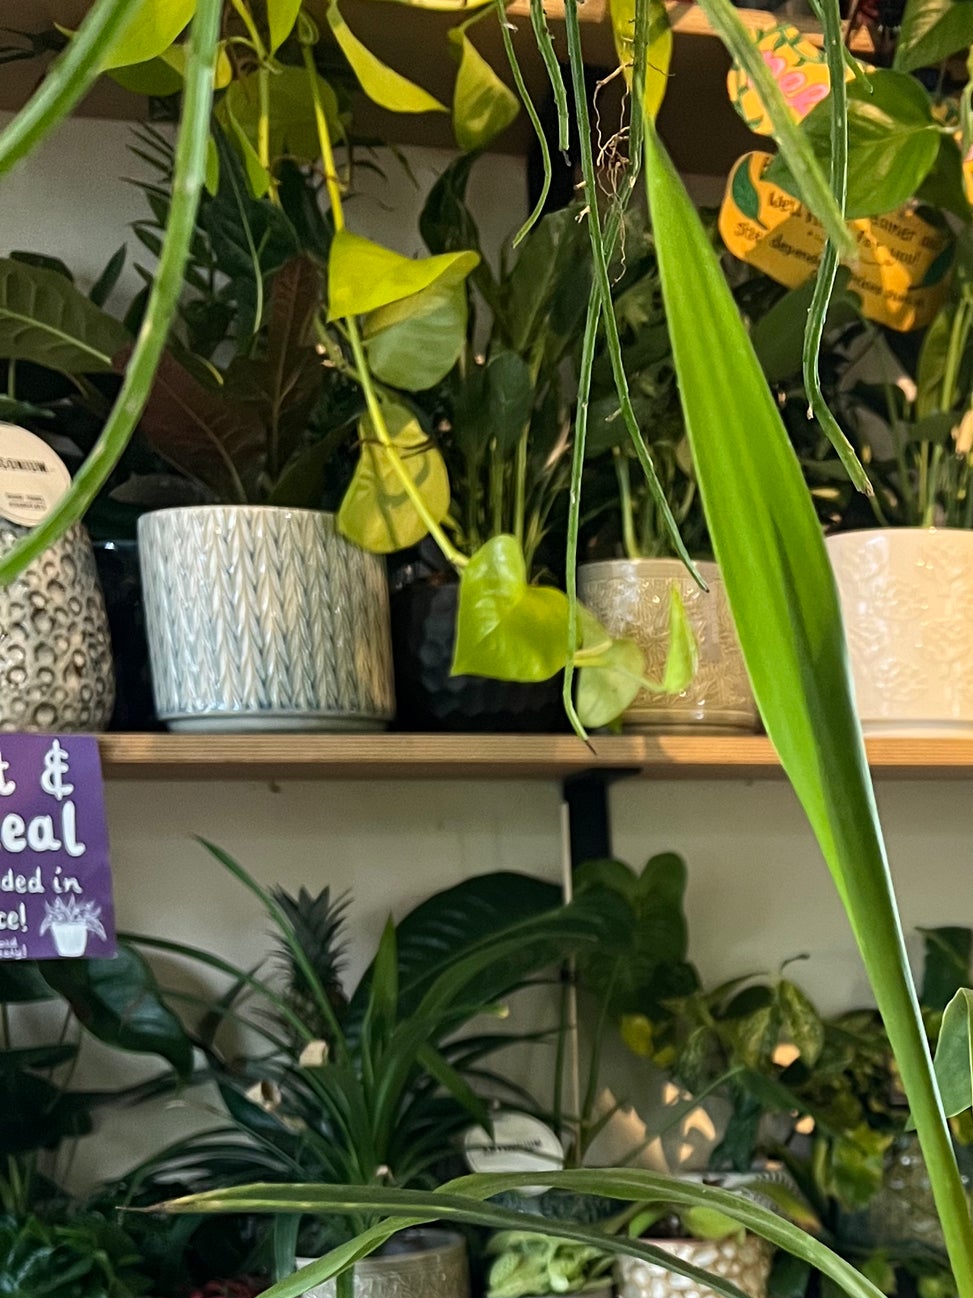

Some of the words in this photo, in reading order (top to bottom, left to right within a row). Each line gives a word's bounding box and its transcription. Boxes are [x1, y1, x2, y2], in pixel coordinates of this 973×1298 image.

[41, 738, 75, 801] &
[1, 866, 46, 894] ded
[52, 866, 84, 895] in
